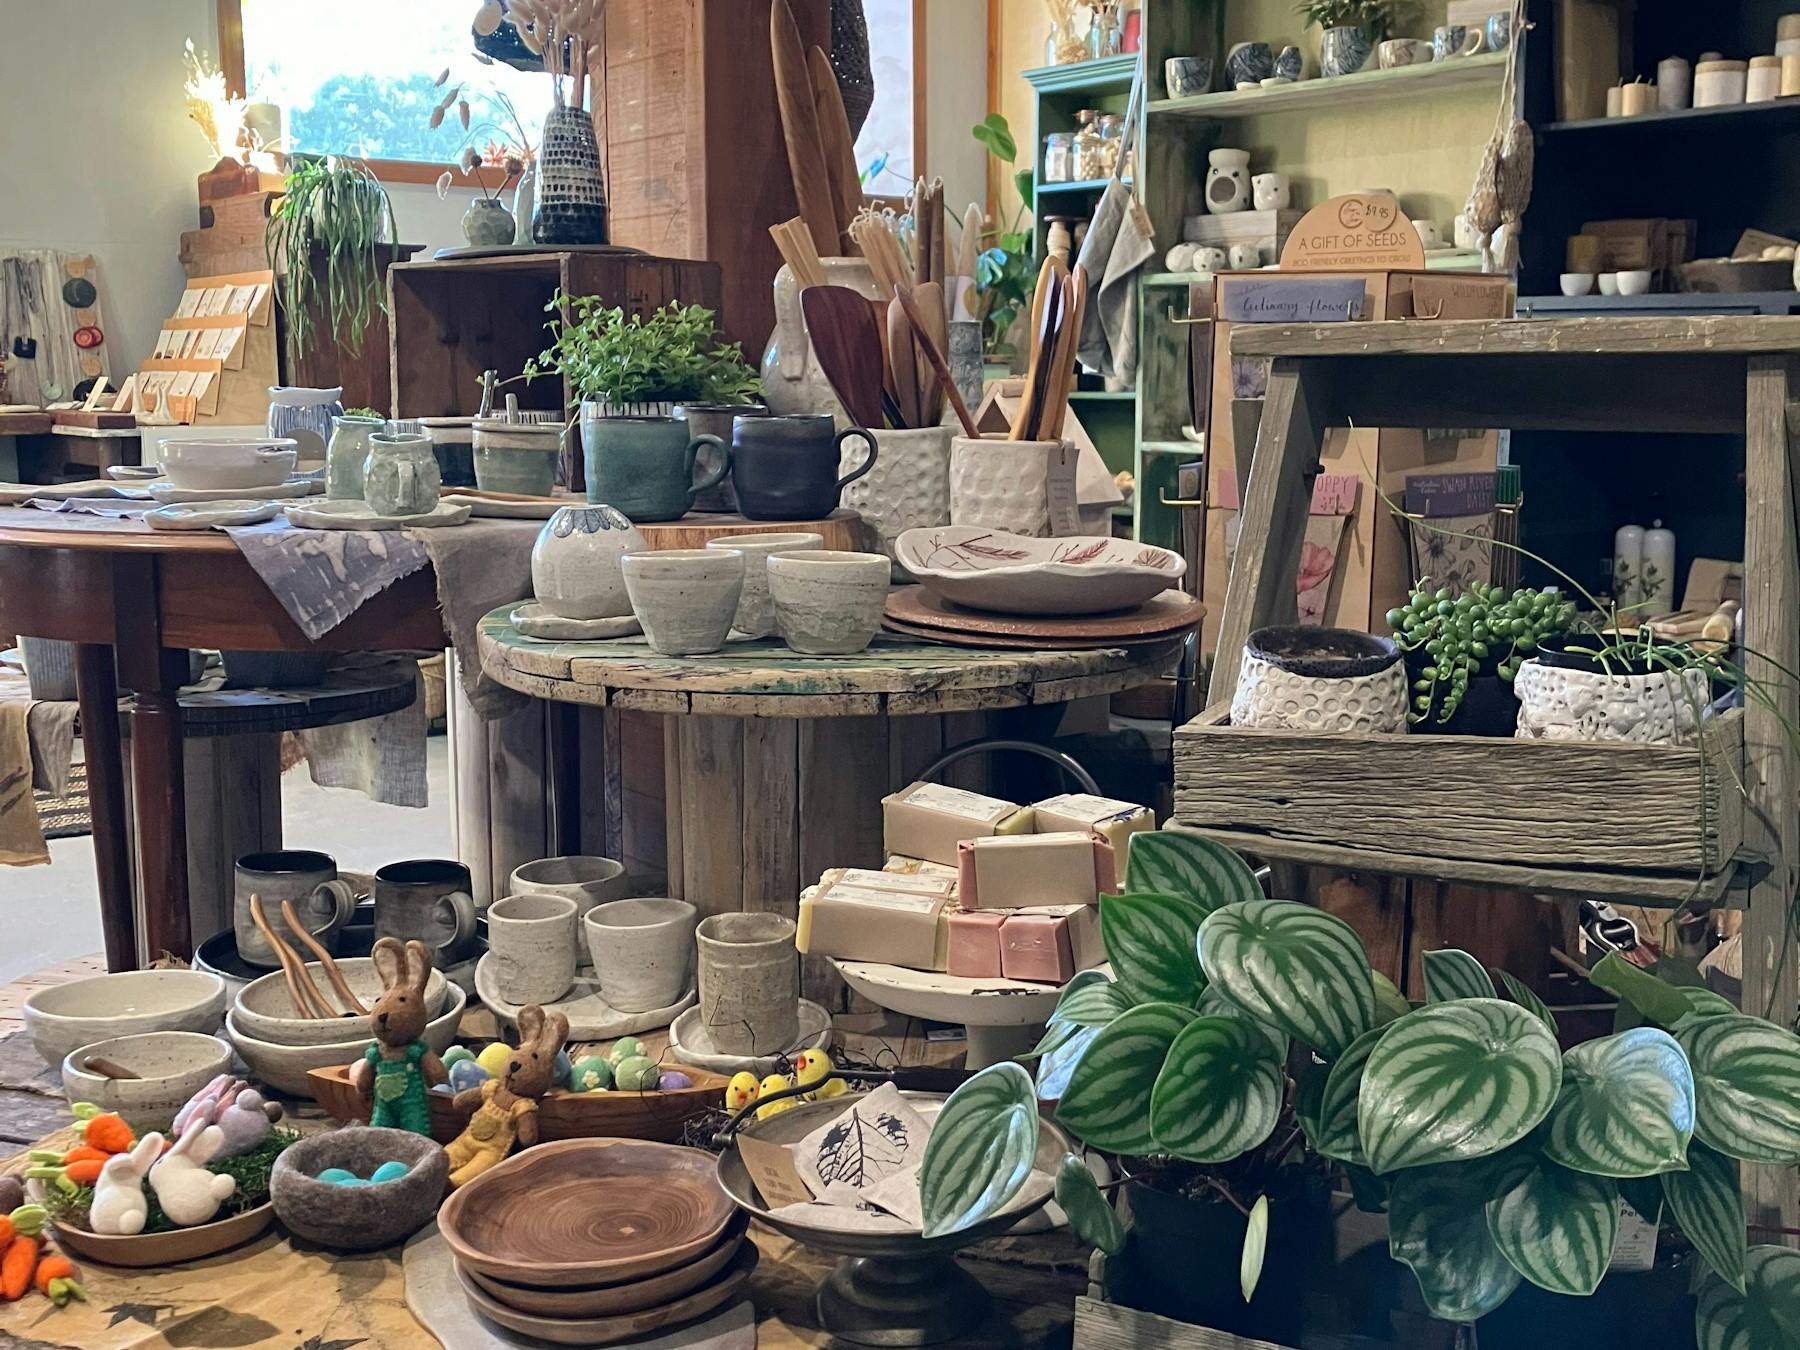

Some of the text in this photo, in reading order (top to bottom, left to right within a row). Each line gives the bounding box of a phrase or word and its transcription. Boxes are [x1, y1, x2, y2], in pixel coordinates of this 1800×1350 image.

[1298, 232, 1407, 250] A GIFT OF SEEDS
[1243, 297, 1360, 317] Culinary flowes
[1316, 475, 1350, 494] OPPY
